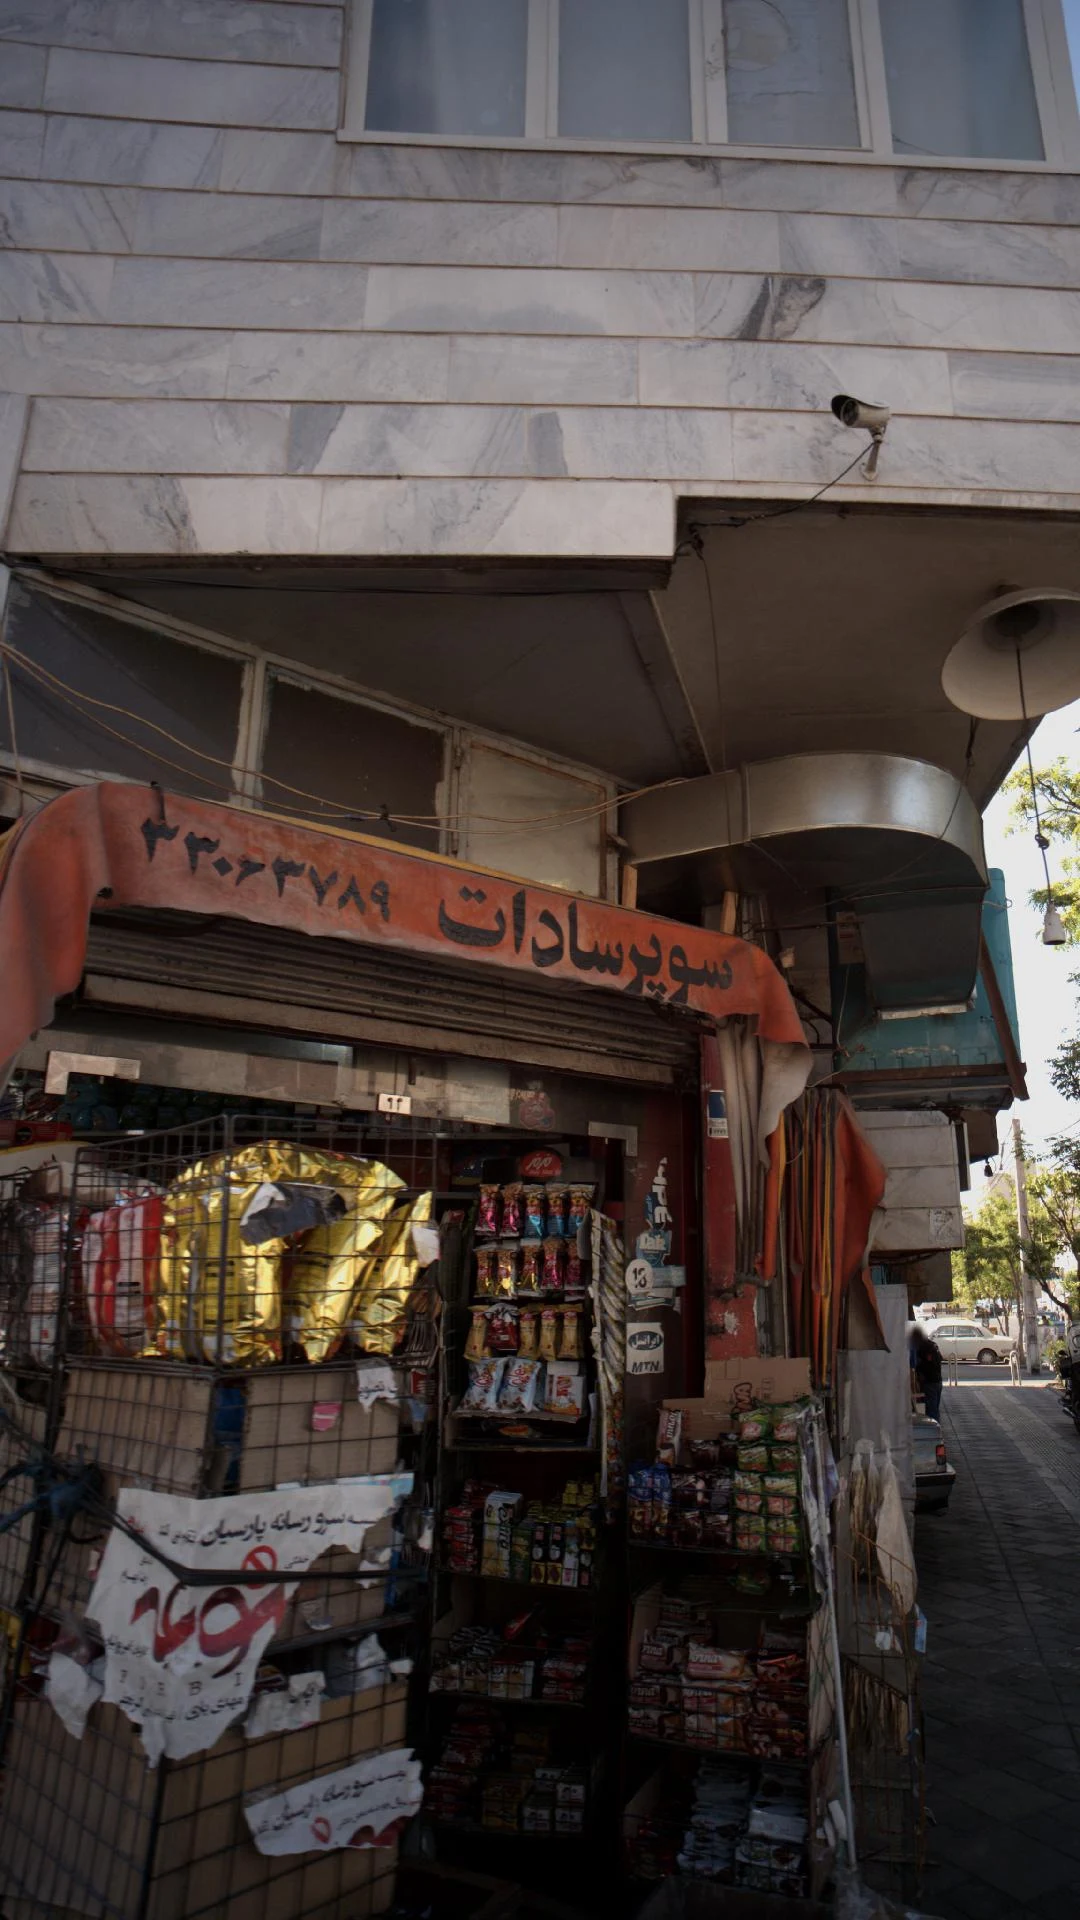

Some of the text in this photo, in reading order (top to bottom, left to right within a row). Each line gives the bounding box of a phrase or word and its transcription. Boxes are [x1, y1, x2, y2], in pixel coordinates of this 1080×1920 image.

[438, 887, 624, 977] سادات
[631, 1361, 660, 1373] MTN
[201, 1514, 268, 1547] پارسیان
[270, 1509, 312, 1534] رسانه
